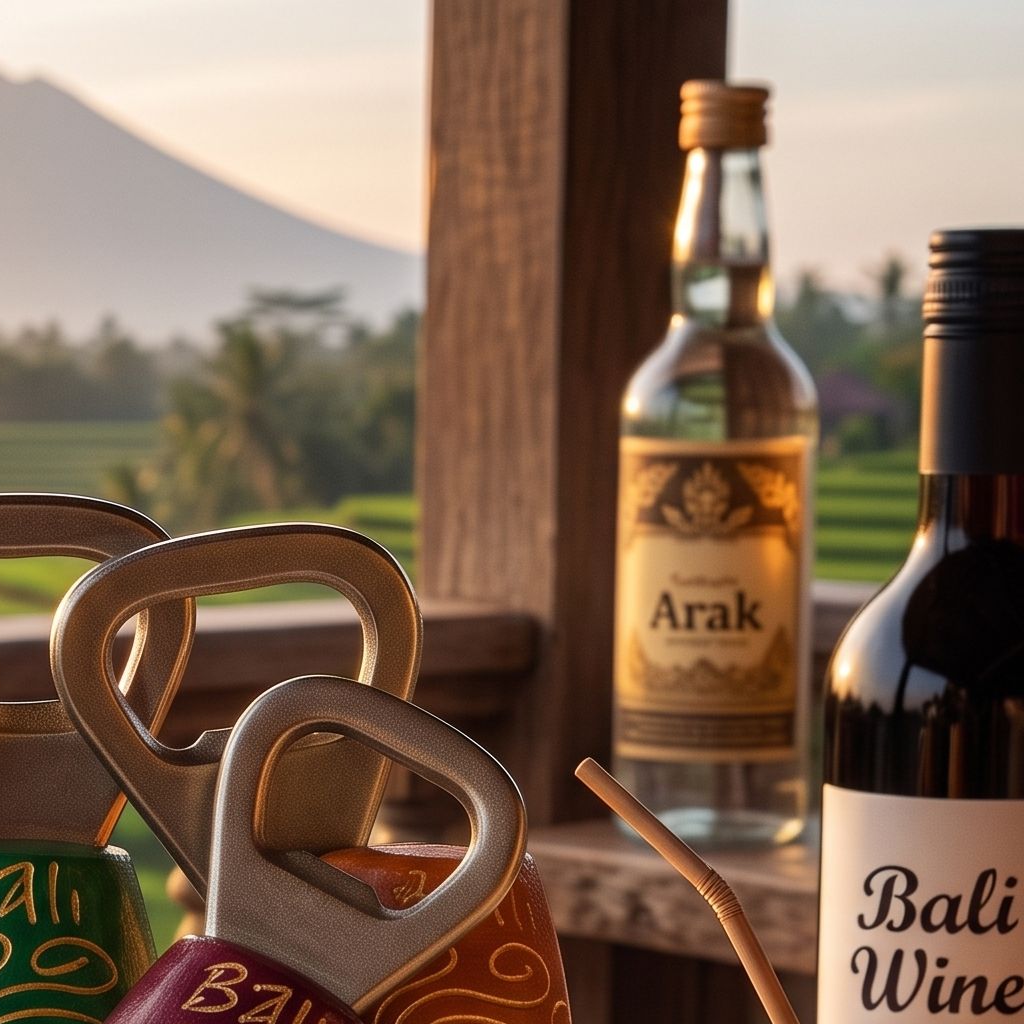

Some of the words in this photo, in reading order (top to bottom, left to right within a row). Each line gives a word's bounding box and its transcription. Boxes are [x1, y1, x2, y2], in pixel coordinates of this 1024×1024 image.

[649, 590, 763, 631] Arak
[857, 865, 1020, 935] Bali
[850, 946, 1024, 1016] Wine
